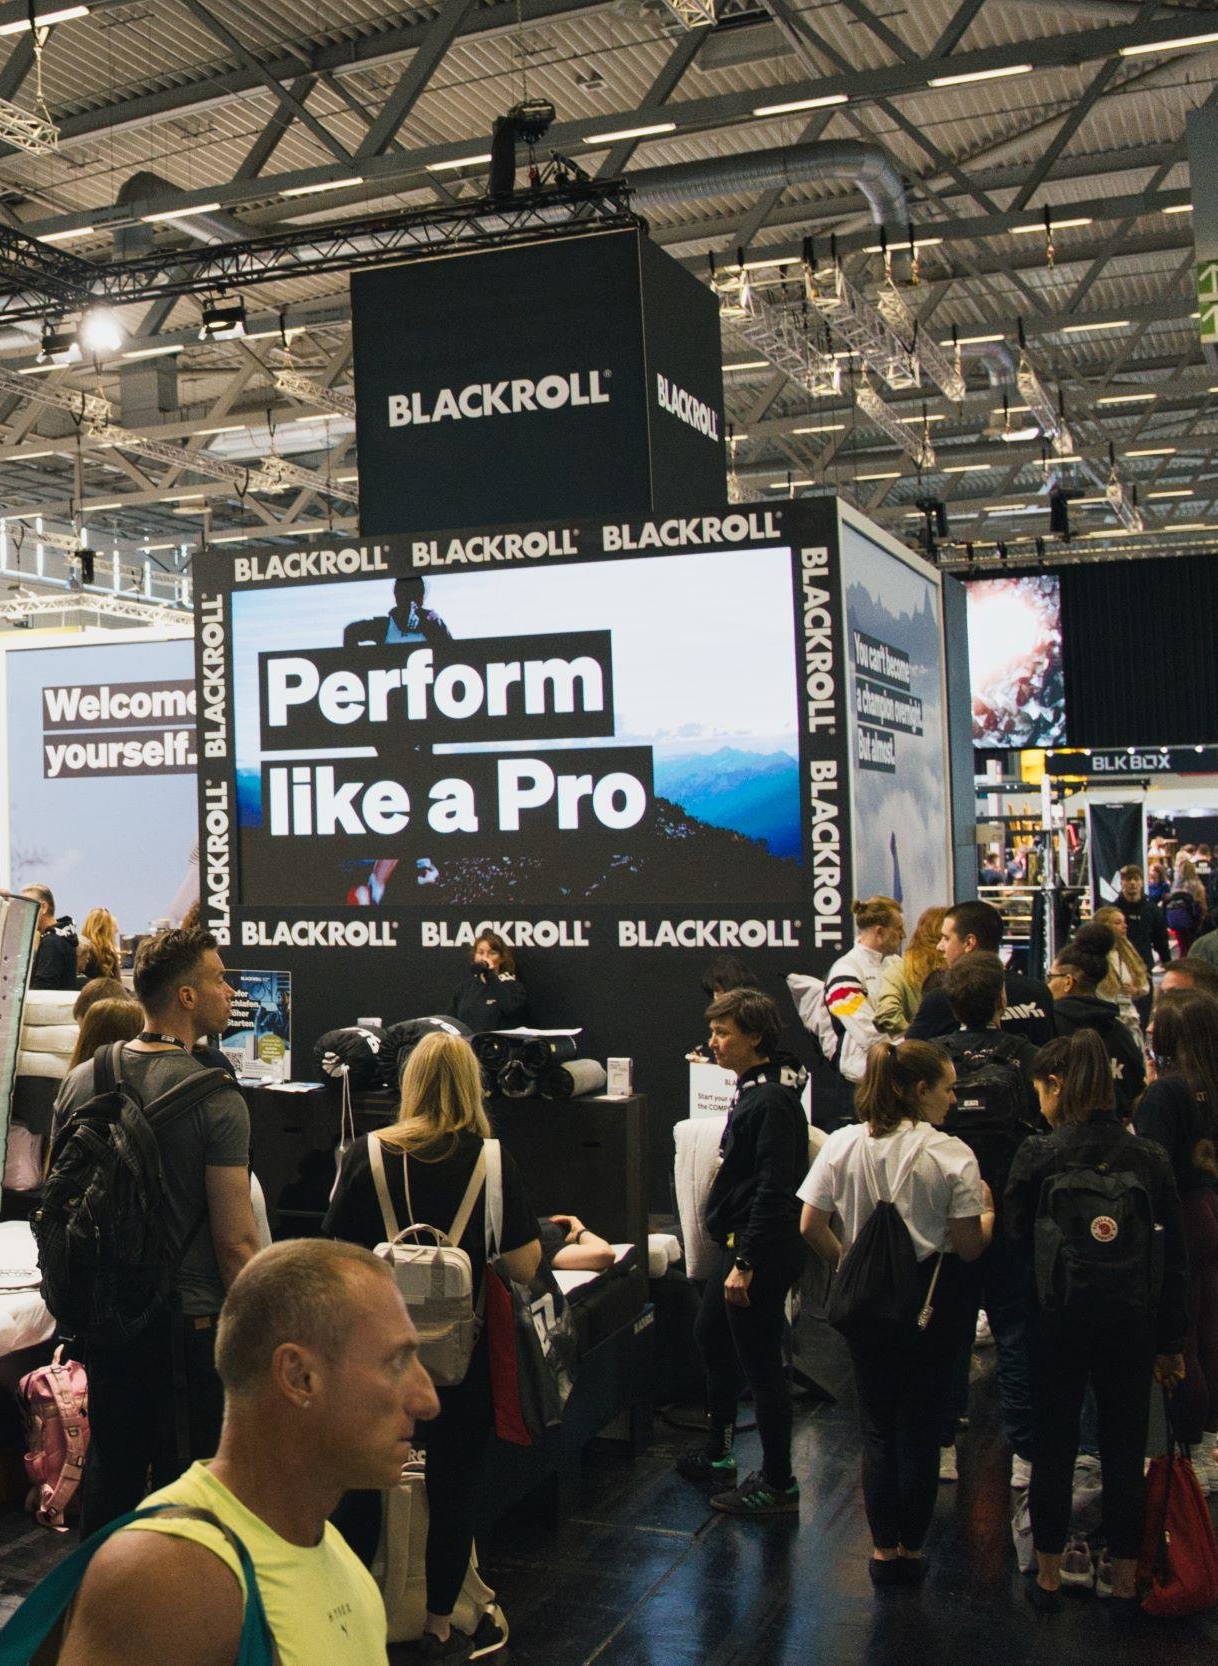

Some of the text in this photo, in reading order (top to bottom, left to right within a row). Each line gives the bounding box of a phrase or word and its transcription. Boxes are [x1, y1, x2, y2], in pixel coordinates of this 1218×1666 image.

[267, 648, 604, 727] Perform
[45, 731, 198, 778] yourself.
[1092, 755, 1171, 771] BLK BOX
[269, 758, 647, 836] like a Pro
